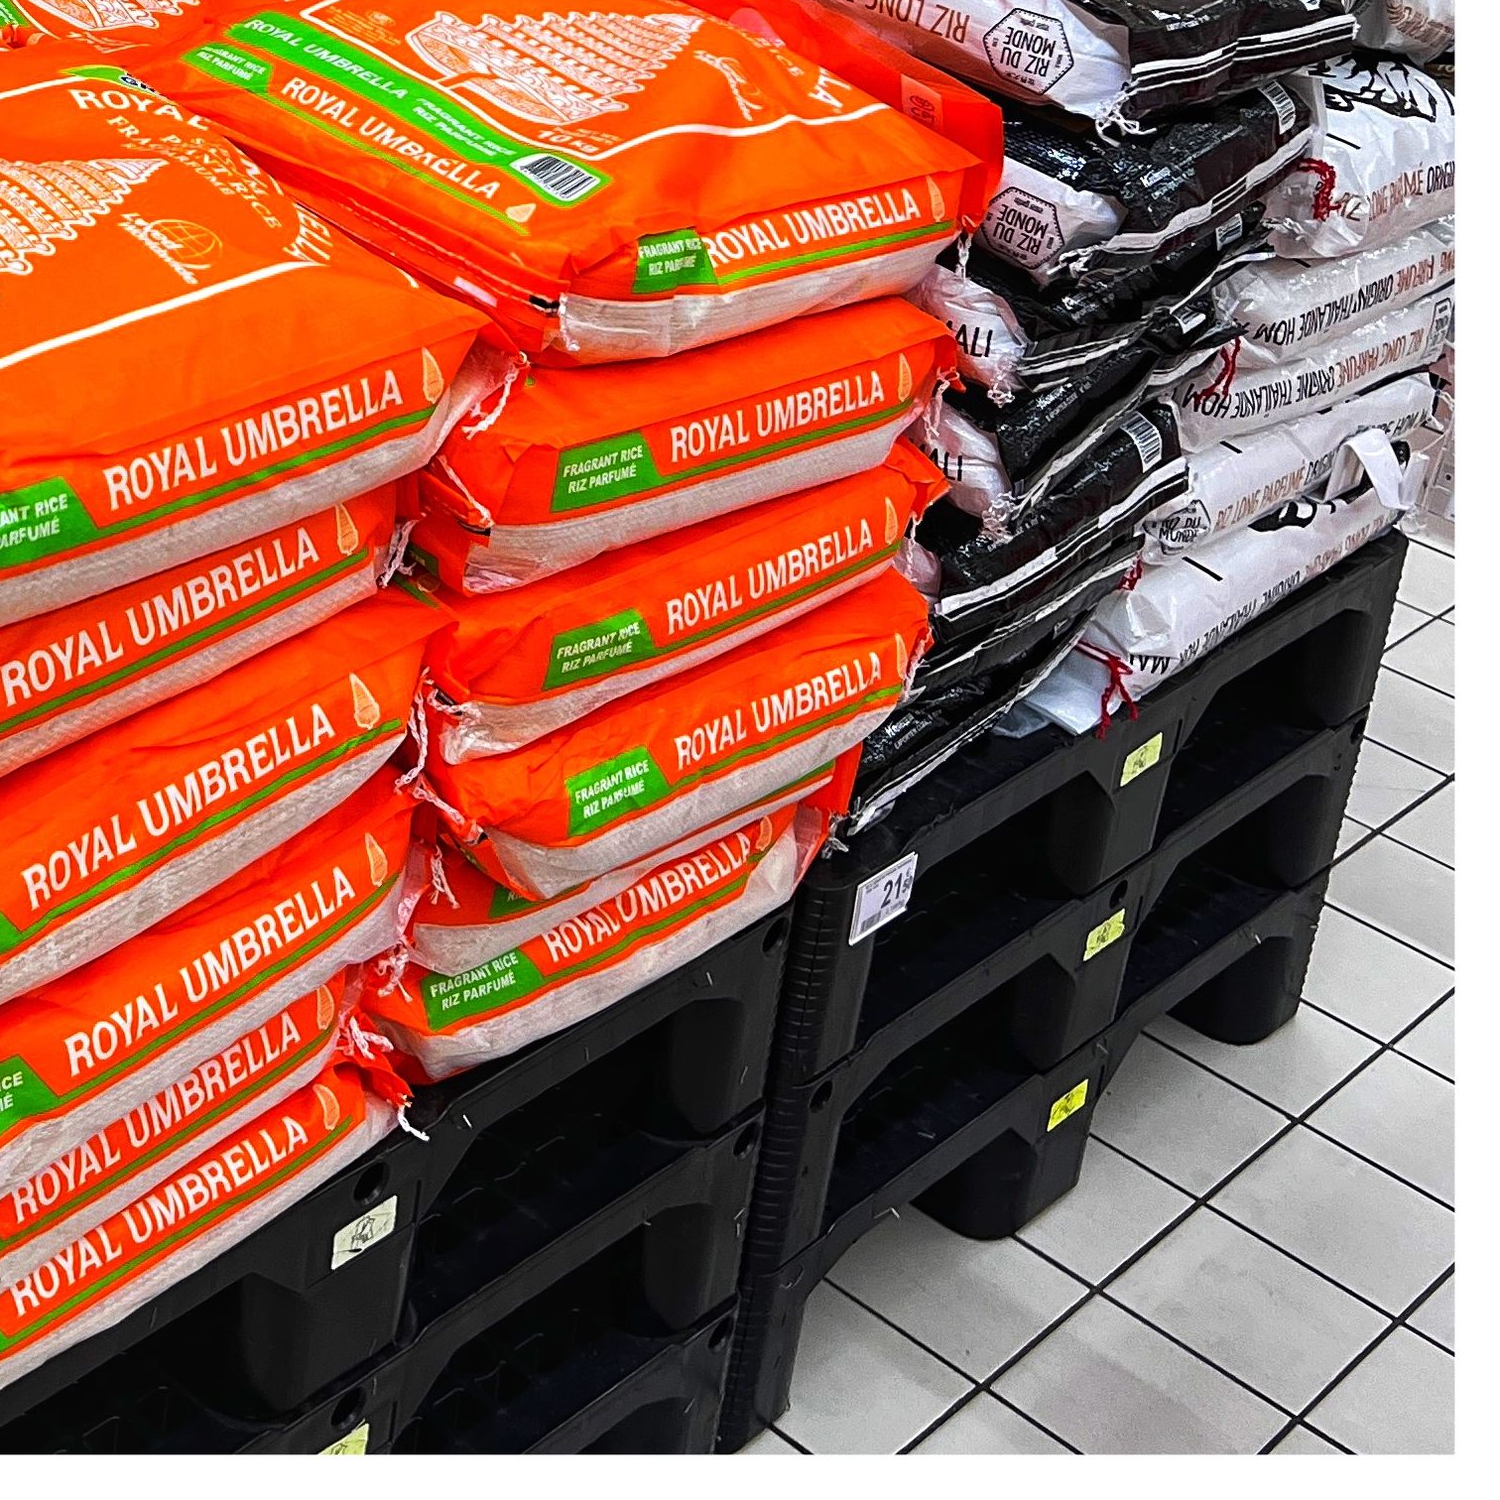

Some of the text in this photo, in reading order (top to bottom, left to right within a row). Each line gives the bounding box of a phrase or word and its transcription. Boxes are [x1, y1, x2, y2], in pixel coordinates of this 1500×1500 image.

[932, 3, 970, 44] RIZ
[1000, 47, 1050, 77] RIZ DU
[1003, 27, 1056, 58] MONDE
[281, 77, 500, 199] ROYAL UMBRELLA
[703, 186, 921, 270] ROYAL UMBRELLA
[996, 203, 1050, 237] MONDE
[101, 369, 404, 512] ROYAL UMBRELLA
[563, 444, 644, 479] FRAGRANT RICE
[670, 370, 886, 464] ROYAL UMBRELLA
[34, 493, 69, 527] RICE
[568, 462, 638, 494] RIZ PARFUMÉ
[124, 526, 321, 647] UMBRELLA
[666, 518, 874, 637] ROYAL UMBRELLA
[674, 715, 748, 772] ROYAL
[754, 651, 884, 733] UMBRELLA
[19, 702, 337, 911] ROYAL UMBRELLA
[62, 866, 357, 1076] ROYAL UMBRELLA
[10, 1012, 302, 1224] ROYAL UMBRELLA
[8, 1114, 310, 1317] ROYAL UMBRELLA
